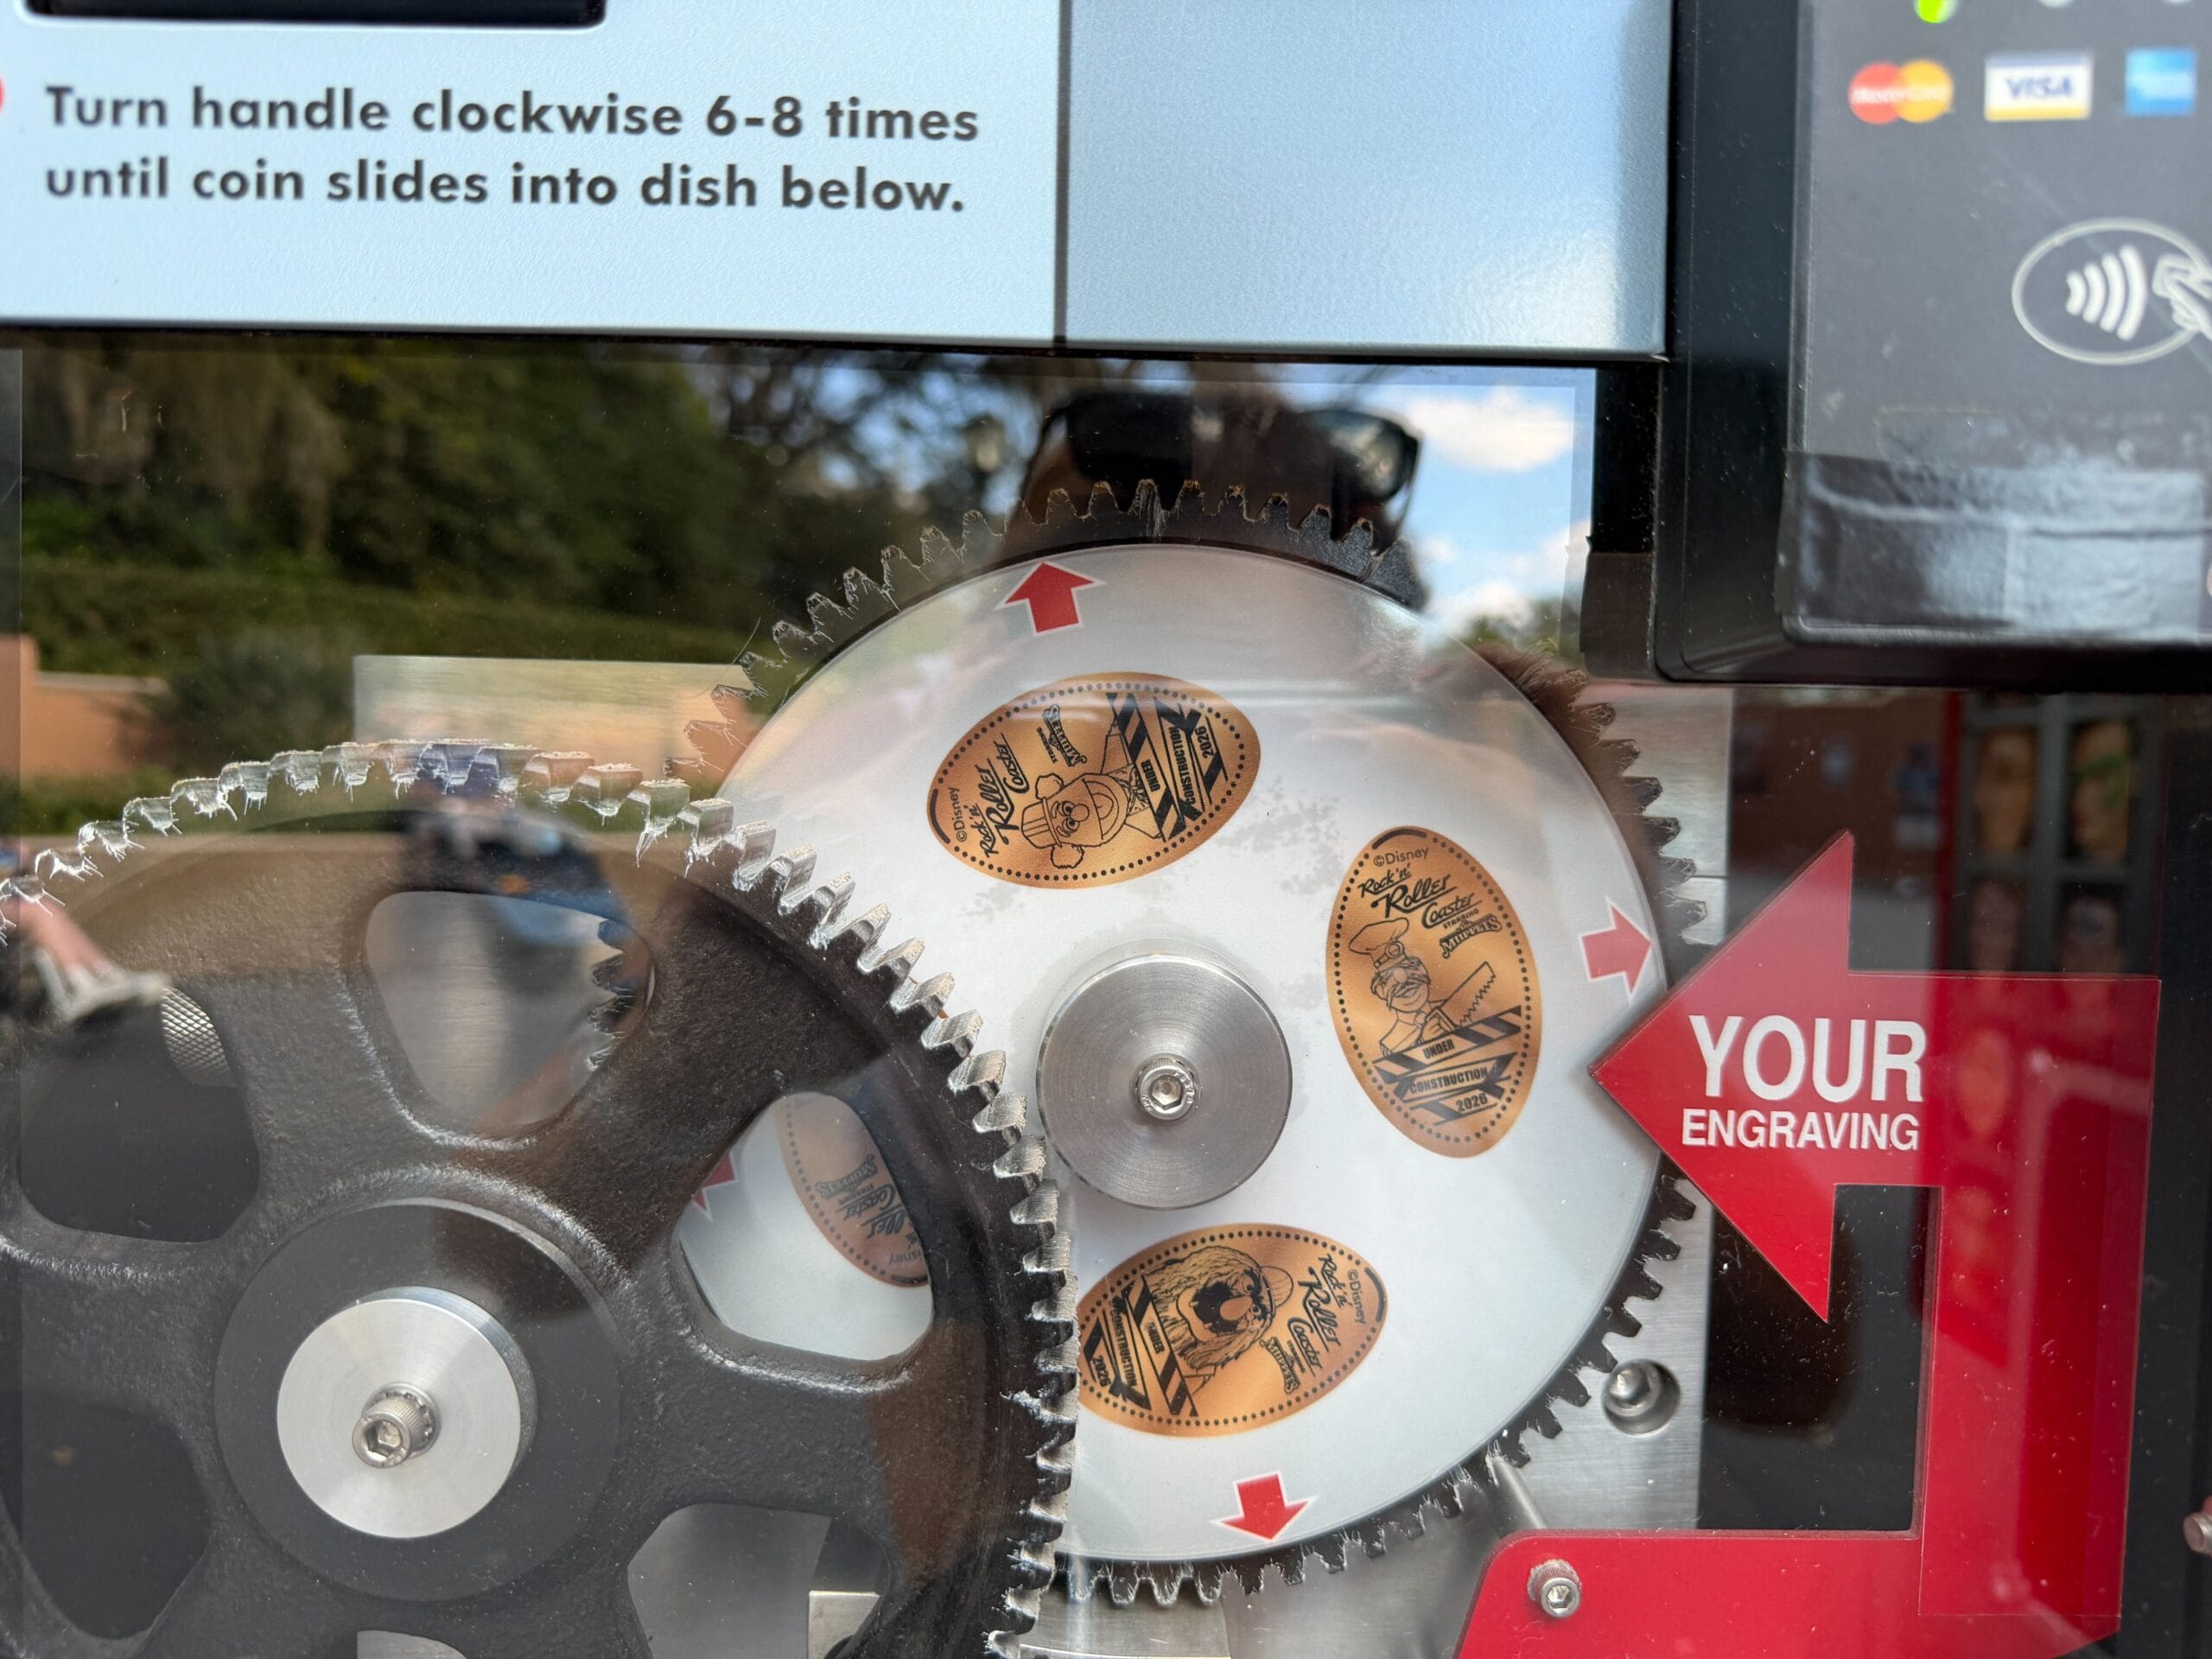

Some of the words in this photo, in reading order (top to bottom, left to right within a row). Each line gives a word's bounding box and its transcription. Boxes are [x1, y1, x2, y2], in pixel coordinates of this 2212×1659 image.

[2005, 76, 2073, 101] VISA
[45, 85, 168, 128] Turn
[193, 85, 391, 130] handle
[412, 88, 683, 136] clockwise
[705, 94, 804, 138] 6-8
[824, 95, 979, 142] times
[46, 155, 168, 199] until
[192, 157, 305, 200] coin
[327, 157, 489, 204] slides
[511, 161, 618, 206] into
[640, 162, 757, 207] dish
[781, 164, 964, 213] below.
[1042, 703, 1087, 767] MUPPETS
[1195, 726, 1215, 760] 2026
[994, 733, 1030, 794] Coaster
[1141, 759, 1160, 792] UNDER
[1168, 726, 1197, 804] CONSTRUCTION
[969, 822, 1000, 858] Rock
[1357, 869, 1395, 898] Rock
[1421, 893, 1483, 929] Coaster
[1439, 913, 1502, 959] MUPPETS
[1422, 1039, 1456, 1059] UNDER
[1688, 1014, 1927, 1103] YOUR
[1409, 1066, 1489, 1095] CONSTRUCTION
[1455, 1092, 1488, 1113] 2026
[1681, 1108, 1920, 1151] ENGRAVING
[1318, 1254, 1345, 1291] Rock
